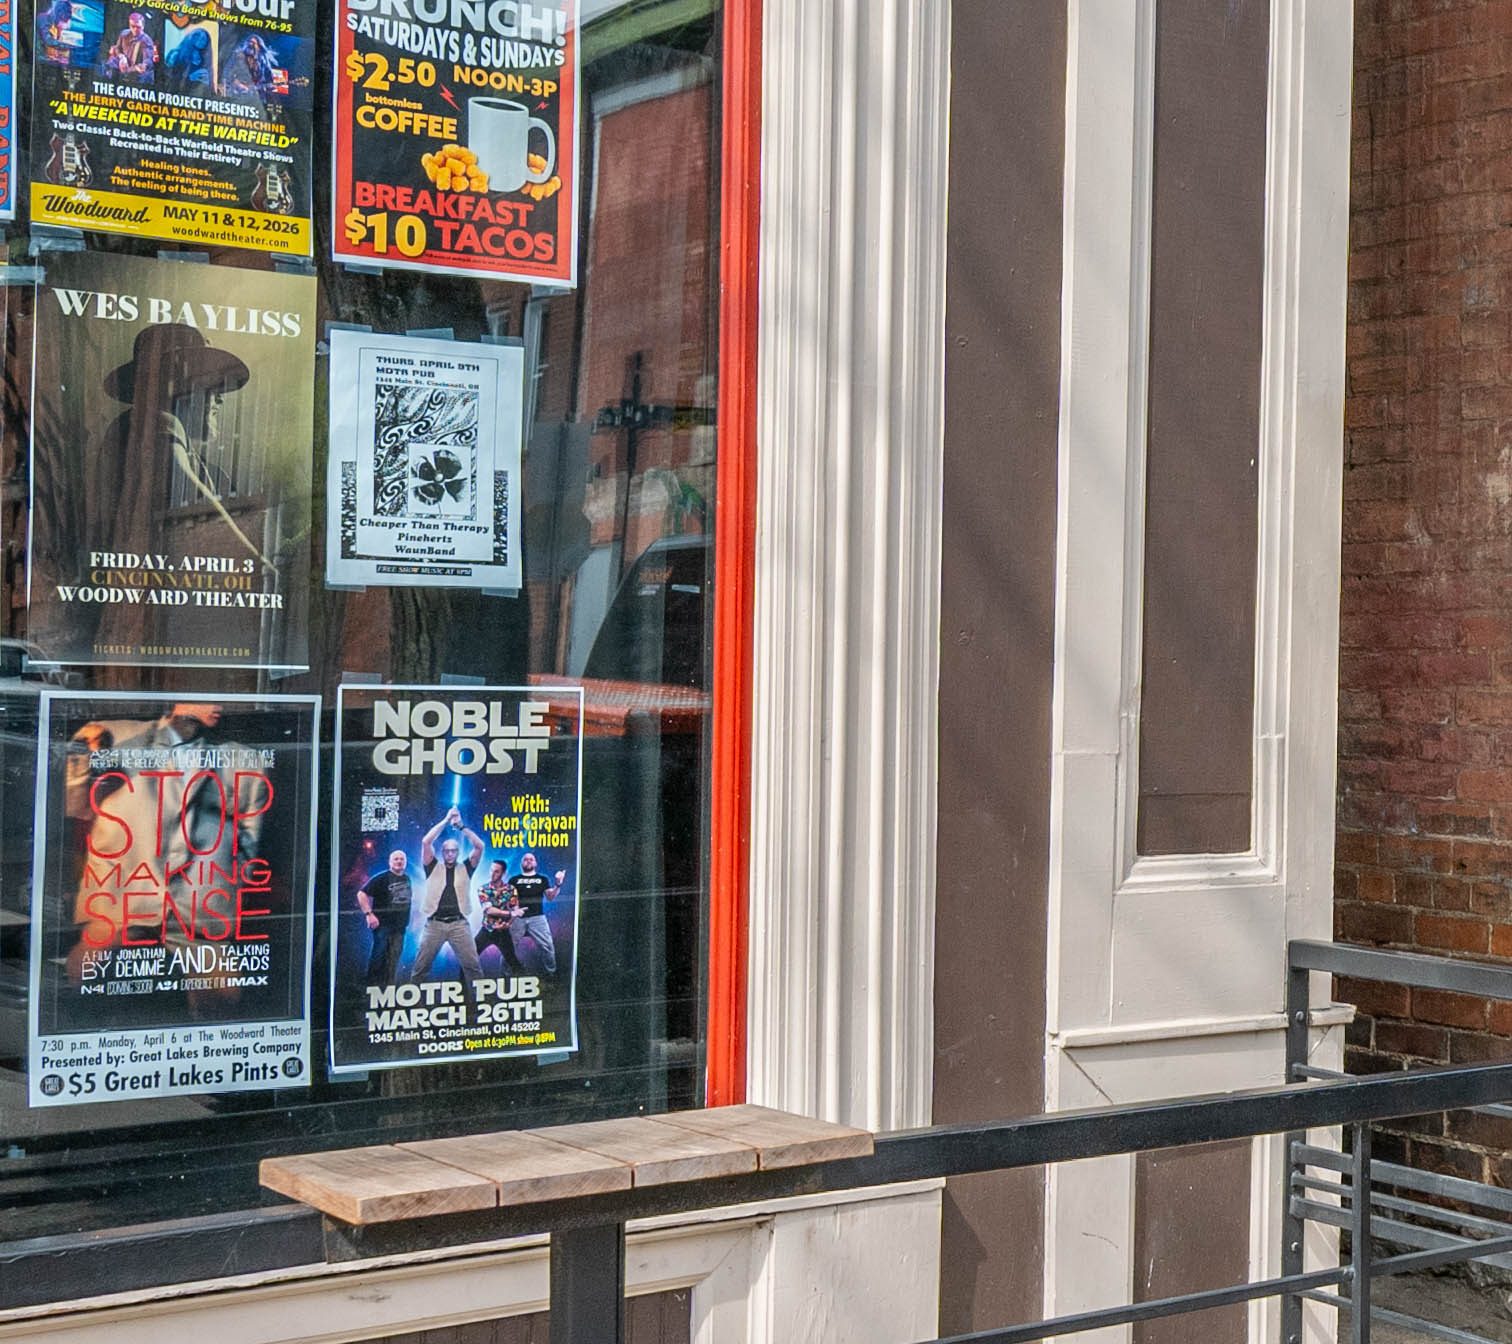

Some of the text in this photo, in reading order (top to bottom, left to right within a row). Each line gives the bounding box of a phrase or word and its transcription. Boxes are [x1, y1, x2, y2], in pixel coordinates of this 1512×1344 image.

[346, 12, 566, 70] SATURDAYS & SUNDAYS
[345, 49, 437, 92] $2.50
[453, 64, 558, 98] NOON-3P
[365, 92, 423, 111] bottomless
[355, 105, 458, 141] COFFEE
[163, 205, 300, 235] MAY 11 & 12, 2026
[355, 180, 534, 229] BREAKFAST
[172, 225, 289, 248] woodwardtheater.com
[344, 206, 427, 258] $10
[434, 220, 556, 263] TACOS
[51, 287, 303, 338] WES BAYLISS
[360, 518, 490, 534] Cheaper Than Therapy
[89, 551, 255, 573] FRIDAY, APRIL 3
[56, 585, 285, 609] WOODWARD THEATER
[372, 700, 550, 738] NOBLE
[372, 738, 550, 775] GHOST
[87, 769, 275, 861] STOP
[510, 794, 550, 813] With:
[483, 812, 577, 834] Neon Caravan
[490, 829, 569, 848] West Union
[84, 858, 273, 889] MAKING
[82, 887, 272, 948] SENSE
[366, 976, 540, 1010] MOTR PUB
[365, 1000, 543, 1031] MARCH 26TH
[42, 1041, 302, 1069] Presented by: Great Lakes Brewing Company
[69, 1061, 278, 1097] $5 Great Lakes Pints
